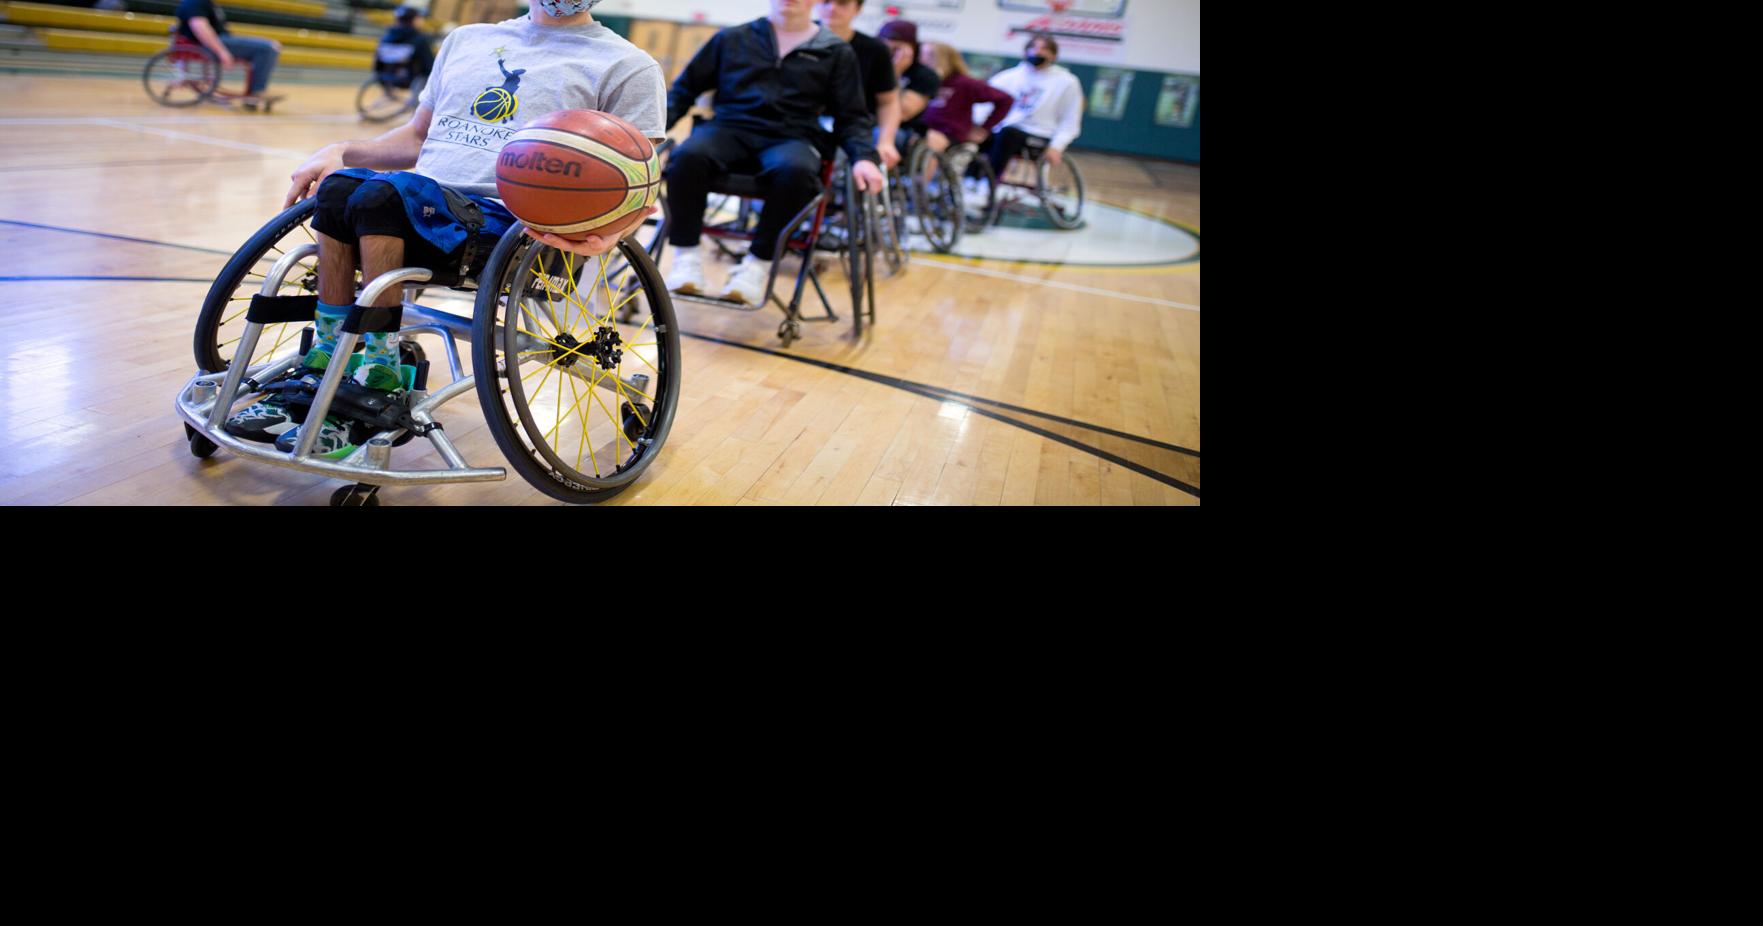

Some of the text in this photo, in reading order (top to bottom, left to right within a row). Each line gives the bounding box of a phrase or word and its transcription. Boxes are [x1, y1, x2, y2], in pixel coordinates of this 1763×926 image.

[438, 117, 513, 140] ROANOKE
[446, 131, 490, 146] STARS
[501, 151, 581, 177] molten
